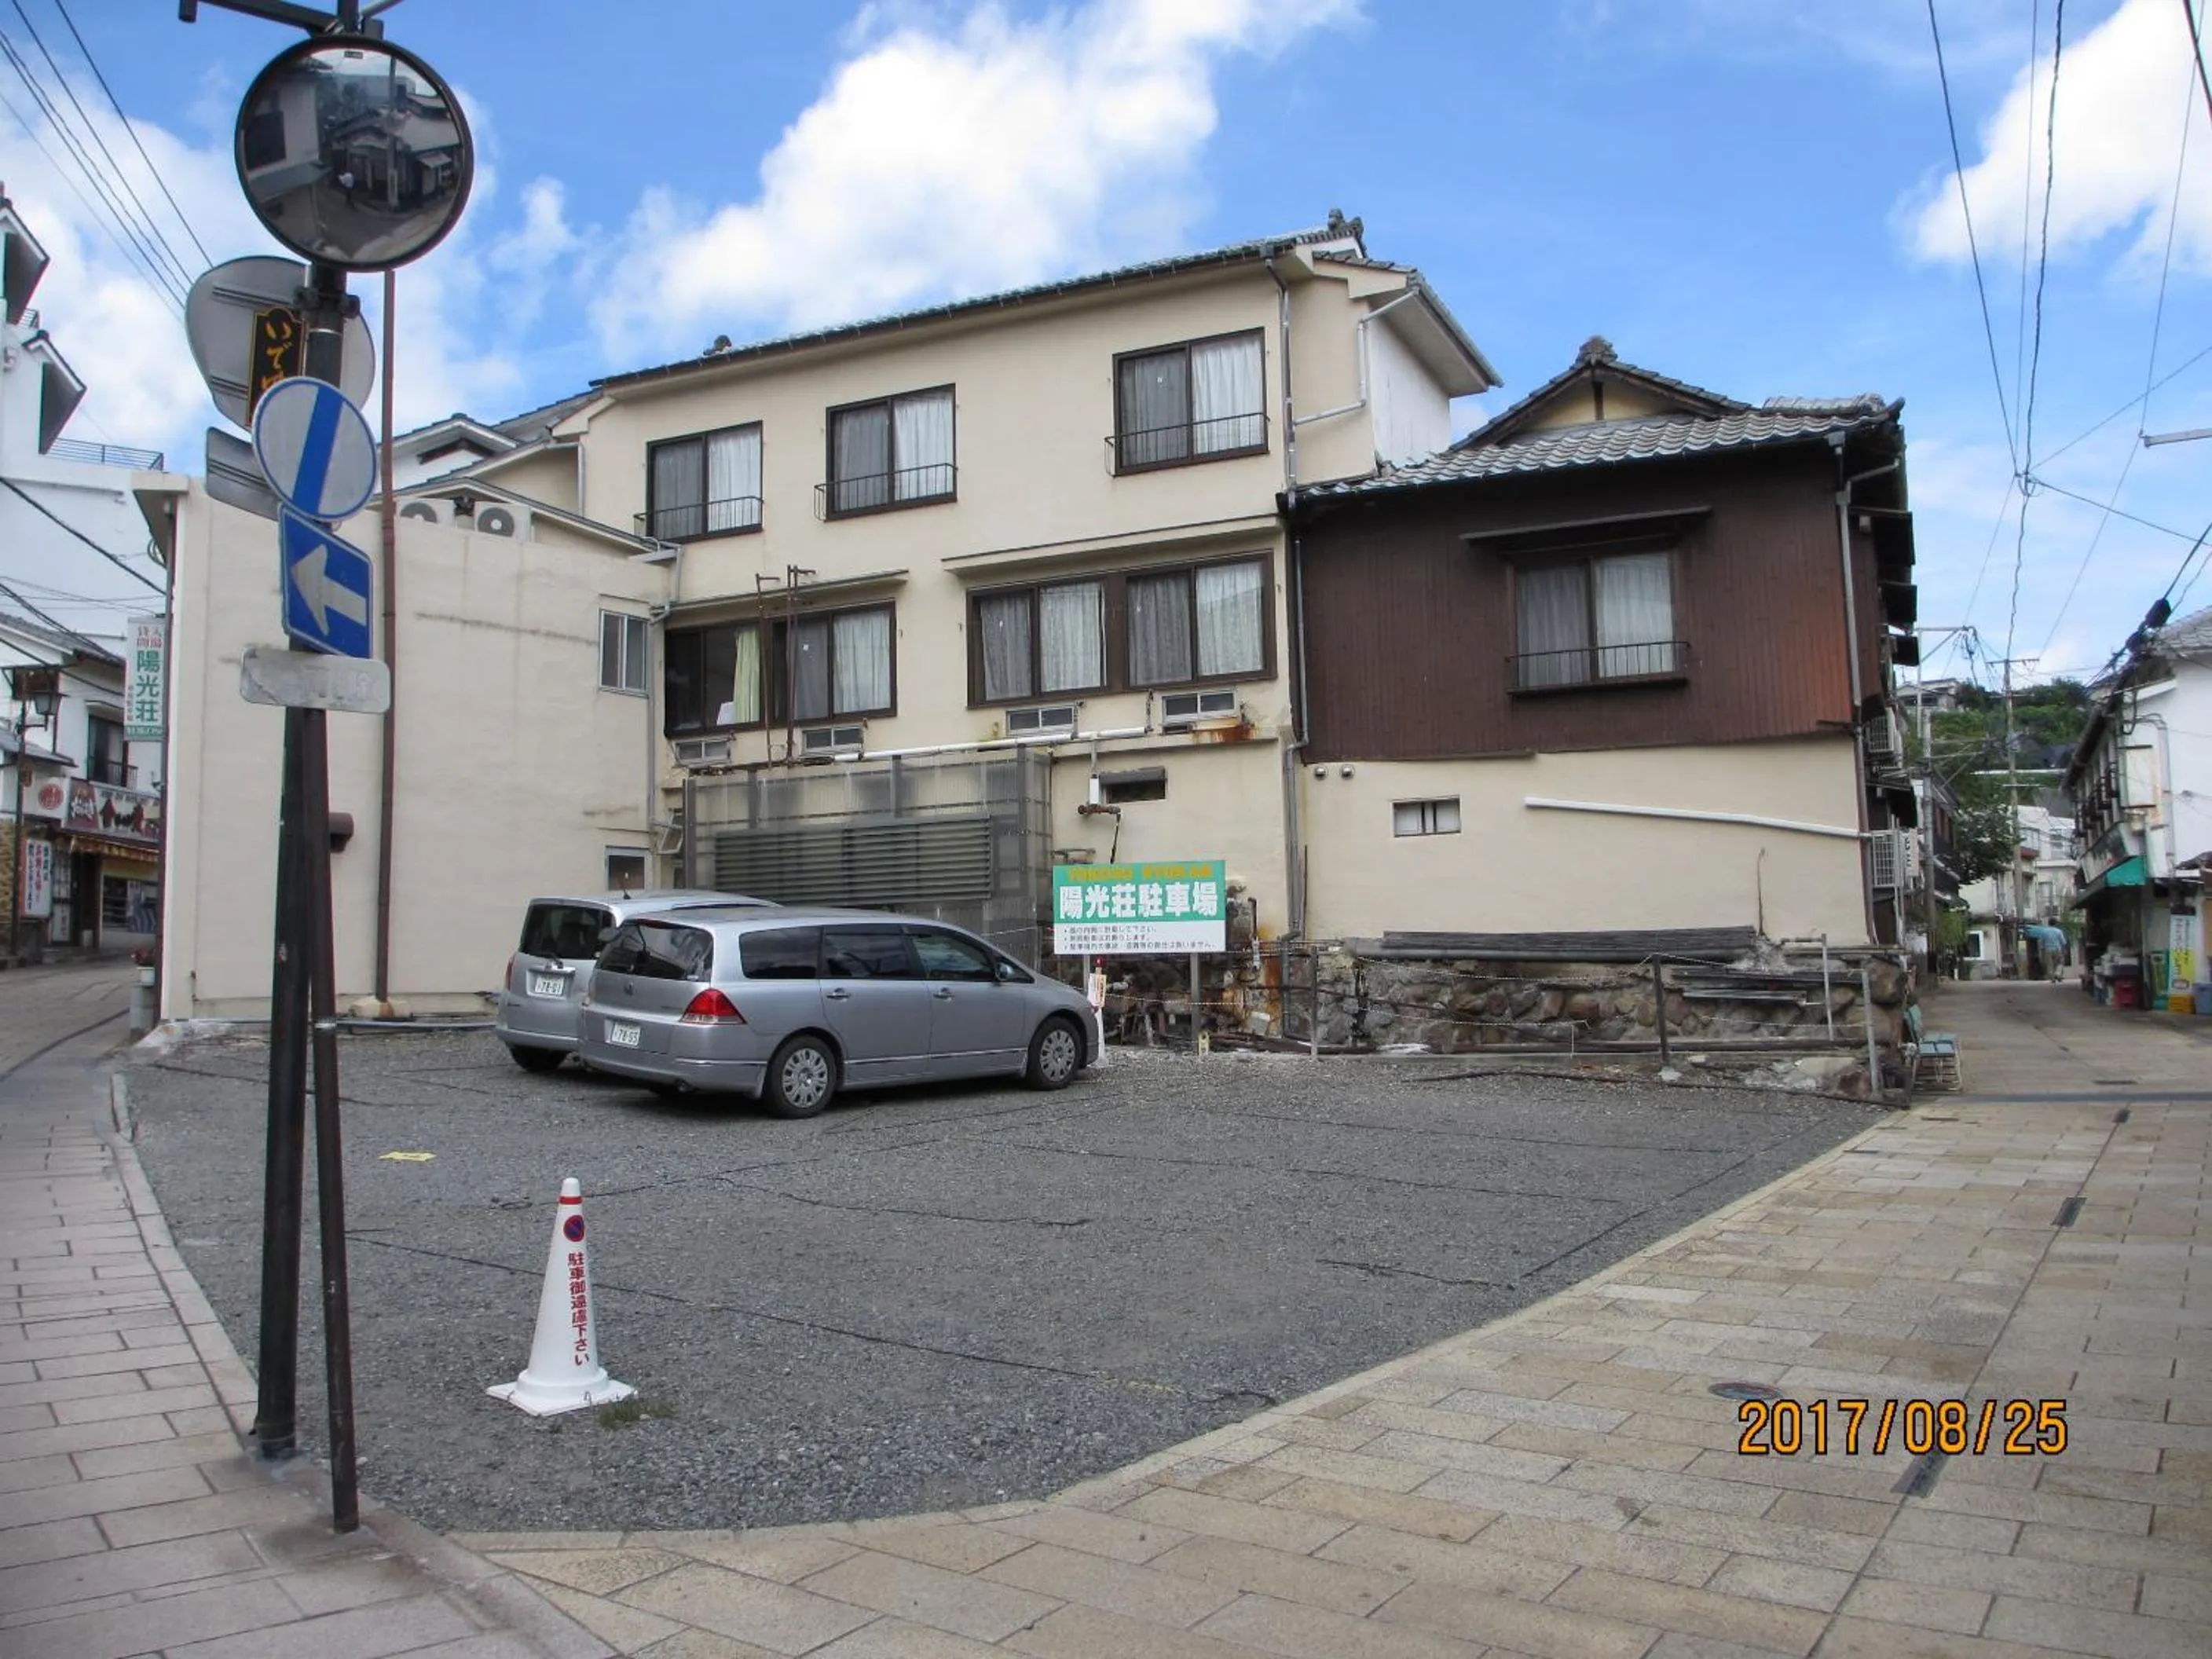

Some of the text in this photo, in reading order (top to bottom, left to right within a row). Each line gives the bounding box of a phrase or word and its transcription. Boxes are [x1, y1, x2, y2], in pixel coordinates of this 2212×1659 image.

[136, 650, 161, 722] 陽光荘
[1059, 881, 1218, 919] 陽光荘駐車場
[567, 1251, 590, 1367] 駐車御遠慮下さい
